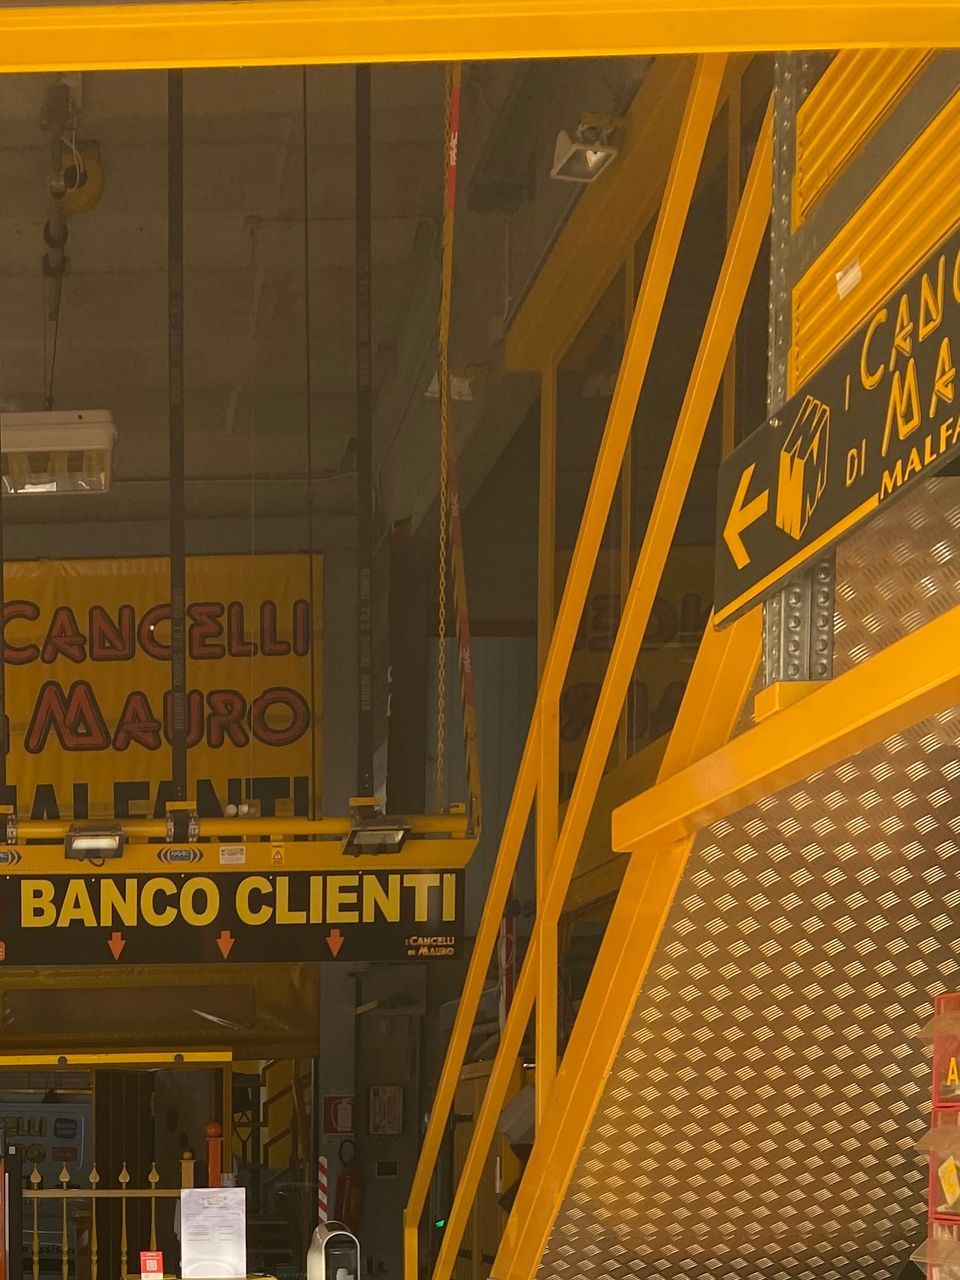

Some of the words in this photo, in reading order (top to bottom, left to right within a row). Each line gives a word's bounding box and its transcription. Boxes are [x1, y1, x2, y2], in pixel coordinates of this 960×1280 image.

[860, 247, 960, 390] CAN
[846, 438, 867, 488] DI
[24, 680, 311, 754] MAURO
[20, 877, 220, 928] BANCO
[235, 873, 456, 926] CLIENTI
[409, 936, 455, 946] CANCELLI
[418, 945, 455, 956] MAURO
